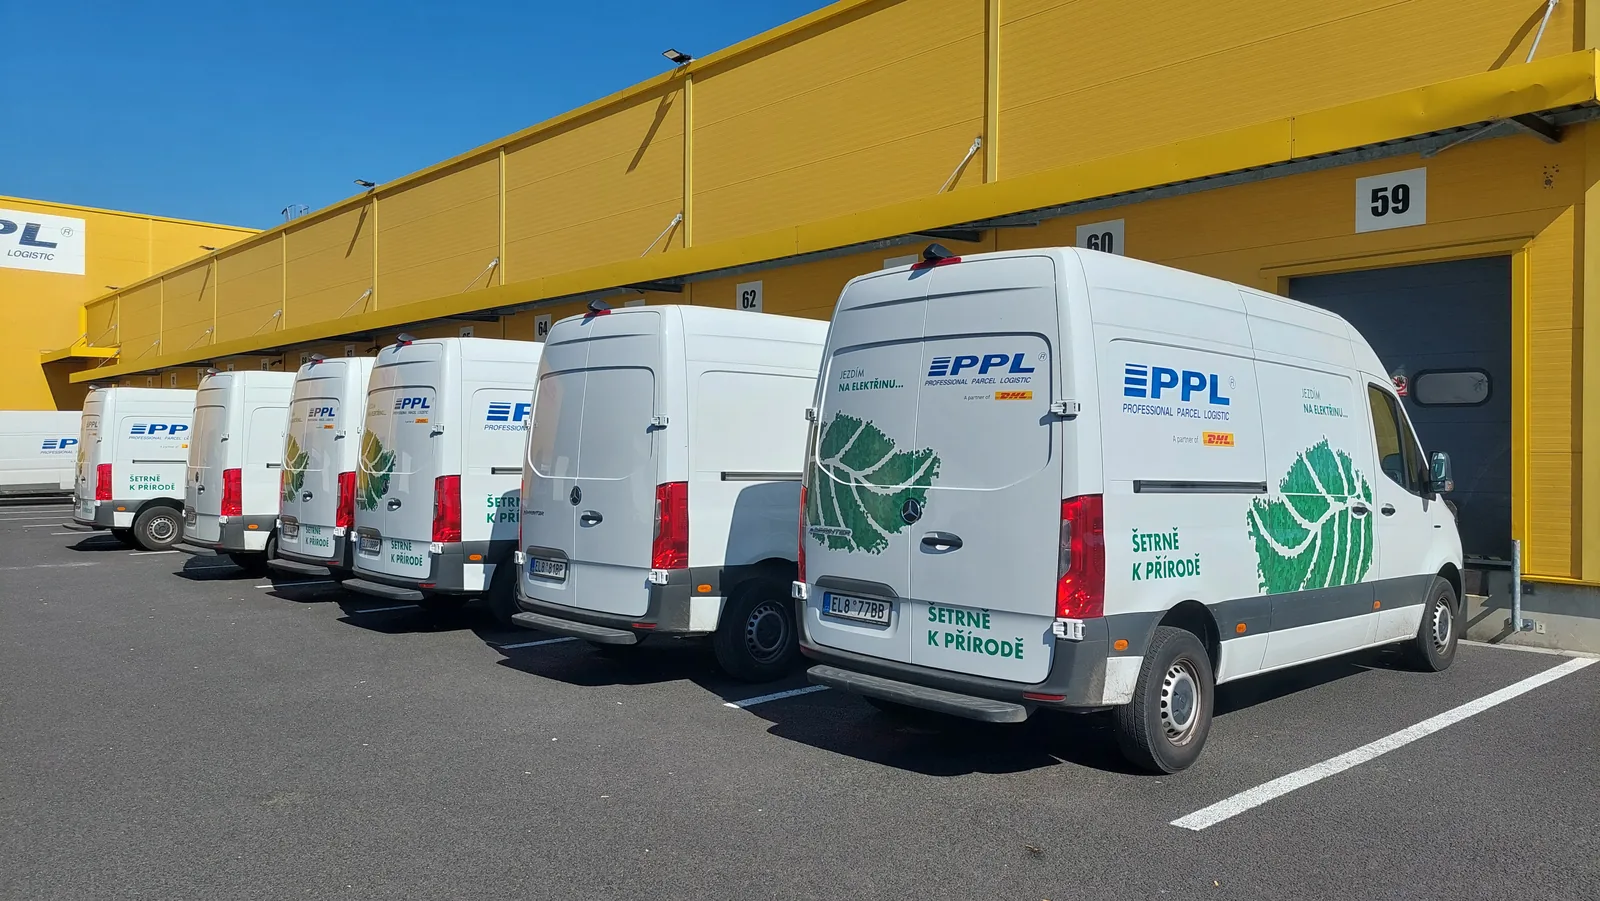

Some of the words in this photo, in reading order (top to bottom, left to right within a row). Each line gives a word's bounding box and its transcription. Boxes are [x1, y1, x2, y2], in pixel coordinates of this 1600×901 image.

[1371, 184, 1410, 217] 59
[1087, 232, 1113, 253] 60
[8, 250, 55, 261] LOGISTIC
[742, 289, 757, 309] 62
[538, 321, 548, 336] 64
[950, 353, 1036, 376] PPL
[840, 366, 865, 379] JEZDÍM
[838, 383, 850, 392] NA
[924, 379, 968, 387] PROFESSIONAL
[1000, 376, 1031, 384] LOGISTIC
[1150, 366, 1230, 406] PPL
[999, 391, 1028, 400] DHL
[1301, 386, 1321, 400] JEZDÍM
[1122, 403, 1173, 417] PROFESSIONAL
[1176, 408, 1201, 419] PARCEL
[1204, 410, 1230, 421] LOGISTIC
[1303, 403, 1313, 414] NA
[147, 424, 189, 435] PP
[1206, 433, 1231, 445] DHL
[486, 513, 495, 523] K
[1132, 526, 1180, 553] ŠETRNĚ
[390, 553, 396, 563] K
[1132, 562, 1142, 581] K
[1146, 552, 1201, 580] PŘÍRODĚ
[928, 601, 991, 630] ŠETRNĚ
[928, 629, 940, 647] K
[944, 628, 1024, 660] PŘÍRODĚ
